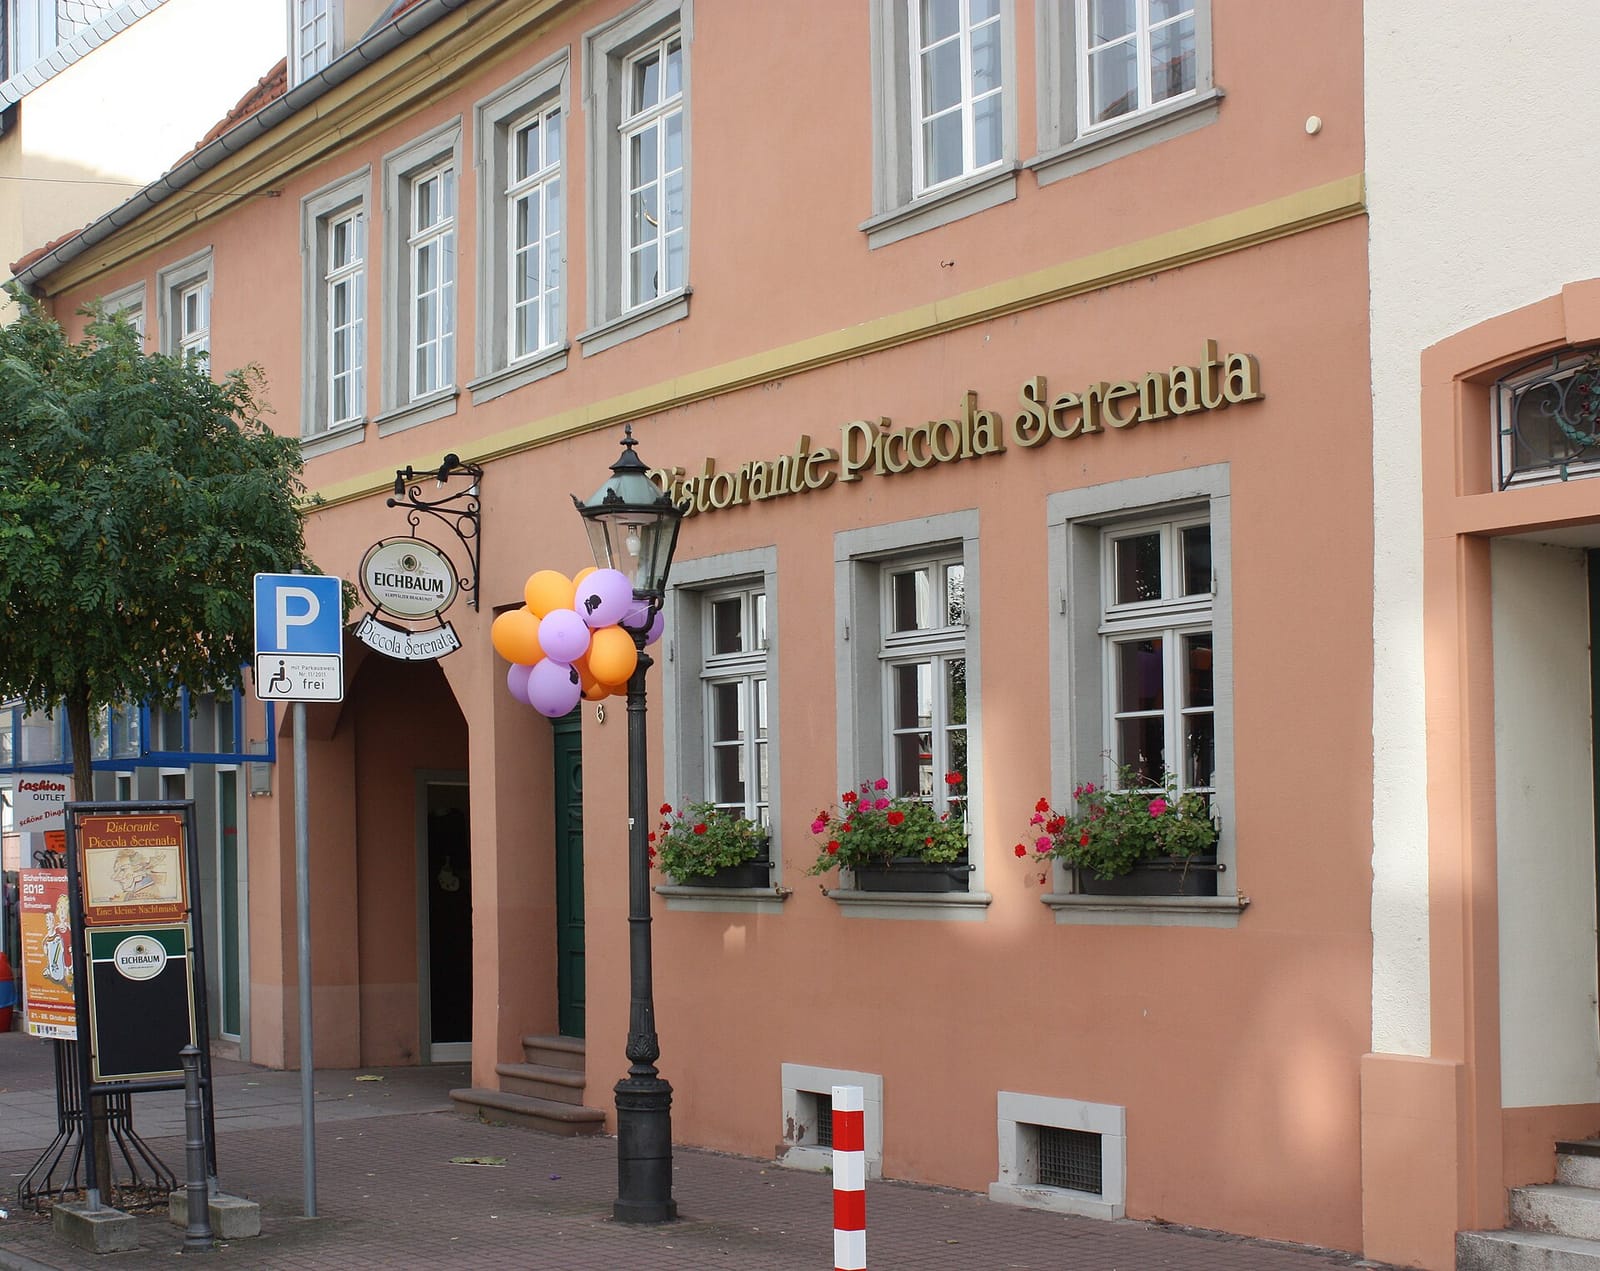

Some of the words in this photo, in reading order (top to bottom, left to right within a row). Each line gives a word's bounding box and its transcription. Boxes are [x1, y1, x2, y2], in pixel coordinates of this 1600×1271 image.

[839, 389, 1007, 483] Piccola
[1011, 338, 1265, 448] Serenata
[374, 572, 444, 593] EICHBAUM
[276, 586, 320, 650] P
[360, 620, 401, 654] Piccola
[404, 633, 456, 656] Serenata
[303, 678, 325, 690] frei
[596, 703, 605, 723] 6
[18, 779, 66, 793] fashion
[20, 815, 43, 826] schöne
[106, 821, 159, 833] Ristorante
[88, 836, 127, 848] Piccola
[130, 835, 176, 847] Serenata
[23, 884, 44, 894] 2012
[139, 904, 178, 914] Nachtmusik
[121, 955, 160, 965] EICHBAUM
